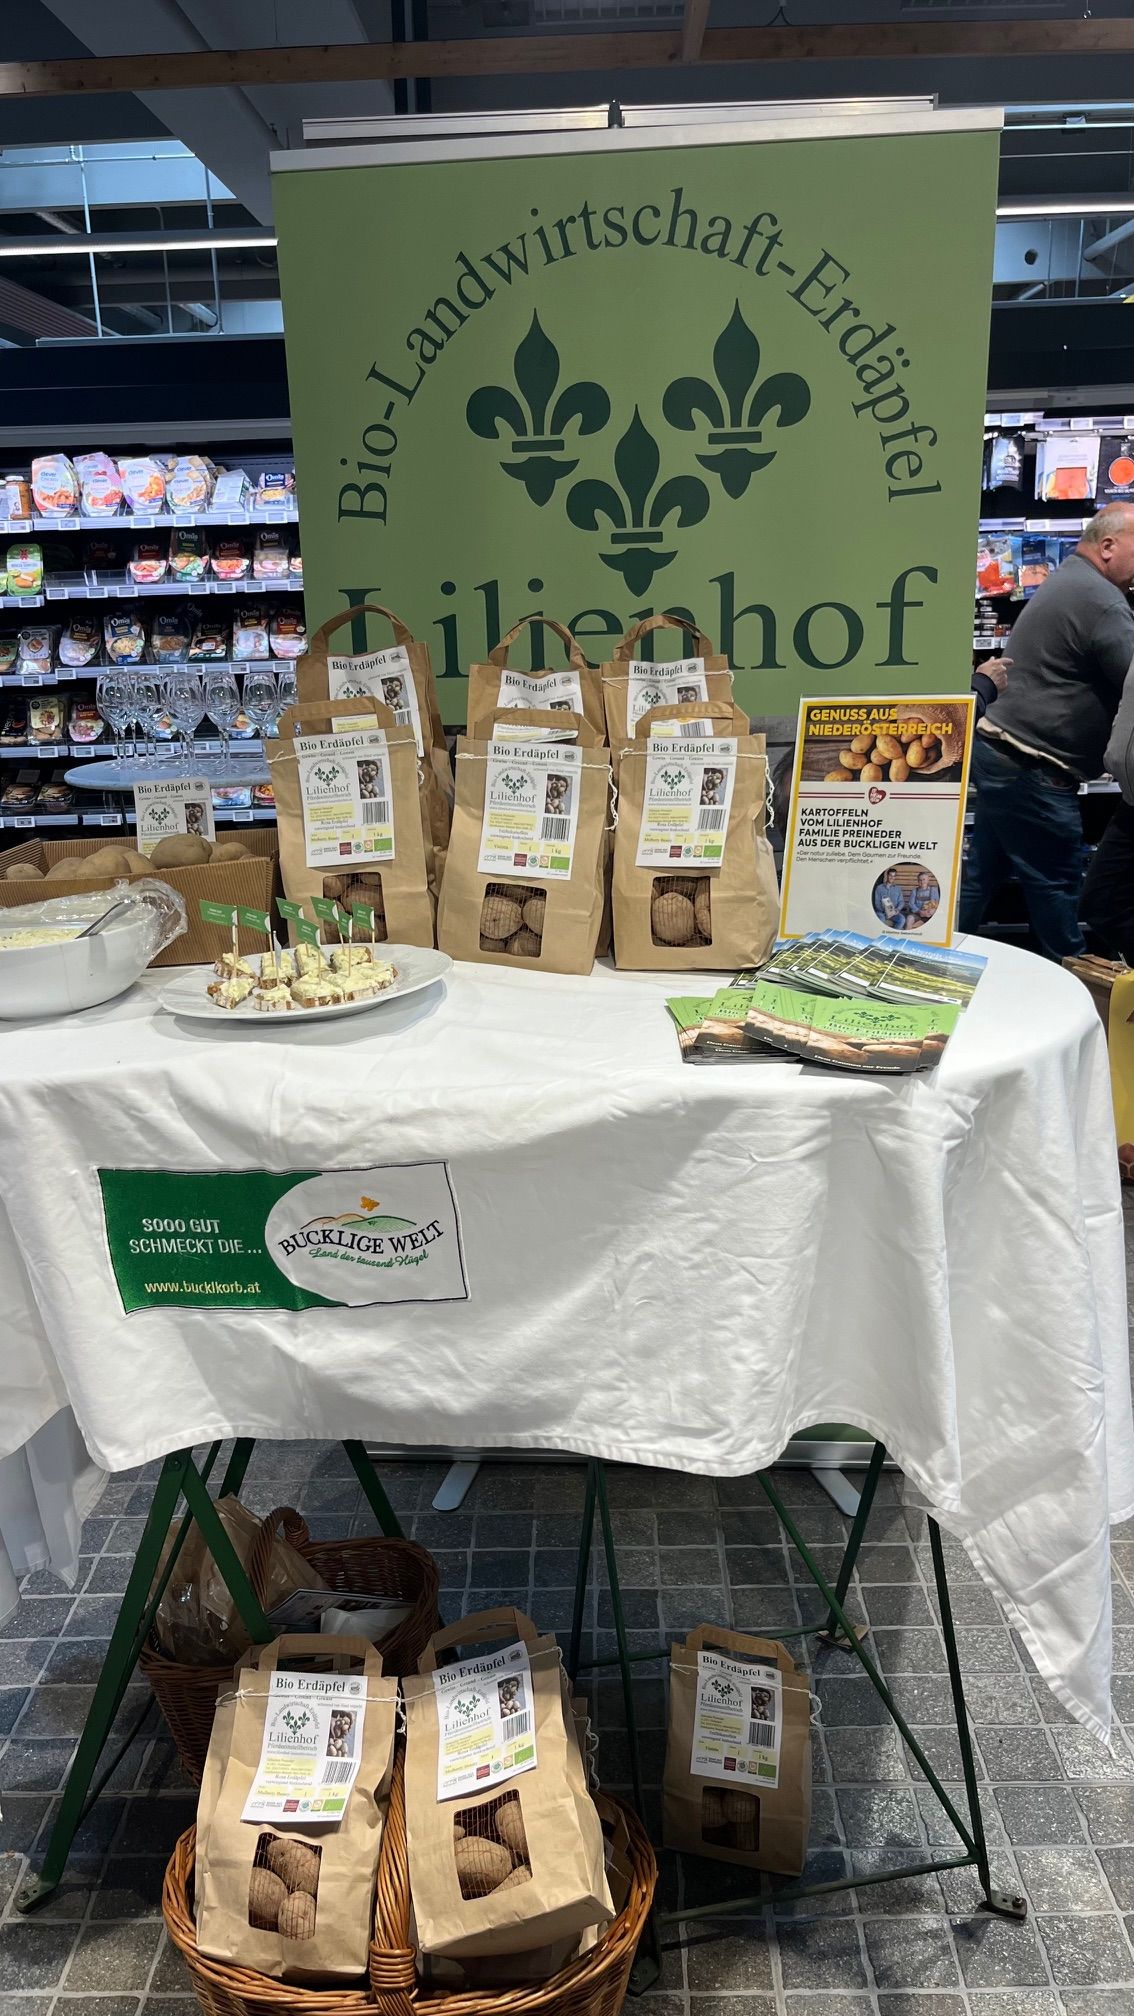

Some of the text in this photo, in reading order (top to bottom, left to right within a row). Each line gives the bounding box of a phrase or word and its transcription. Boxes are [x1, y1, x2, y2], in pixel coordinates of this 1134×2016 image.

[337, 188, 941, 526] Bio-Landwirtschaft-Erdäpfel
[332, 655, 386, 670] Bio Erdäpfel
[634, 665, 683, 678] Bio Erdäpfel
[505, 675, 557, 692] Bio Erdäpfel
[810, 708, 897, 720] GENUSS AUS
[809, 720, 952, 736] NIEDERÖSTERREICH
[300, 736, 364, 751] Bio Erdäpfel
[653, 743, 715, 754] Bio Erdäpfel
[493, 745, 559, 760] Bio Erdäpfel
[138, 782, 191, 794] Bio Erdäpfel
[306, 782, 350, 796] Lilienhof
[649, 788, 694, 797] Lilienhof
[490, 791, 537, 803] Lilienhof
[801, 808, 869, 817] KARTOFFELN
[140, 823, 179, 832] Lilienhof
[800, 818, 883, 828] VOM LILIENHOF
[799, 828, 902, 838] FAMILIE PREINEDER
[798, 838, 938, 850] AUS DER BUCKLIGEN WELT
[142, 1218, 220, 1234] SOOO GUT
[278, 1220, 444, 1256] BUCKLIGE WELT
[130, 1238, 217, 1254] SCHMECKT
[308, 1248, 429, 1268] Land der tausend Hügel
[144, 1281, 261, 1294] www.bucklkorb.at
[439, 1656, 506, 1686] Bio Erdäpfel
[702, 1656, 760, 1677] Bio Erdäpfel
[276, 1678, 346, 1694] Bio Erdäpfel
[701, 1694, 744, 1707] Lilienhof
[444, 1708, 492, 1732] Lilienhof
[269, 1732, 320, 1744] Lilienhof
